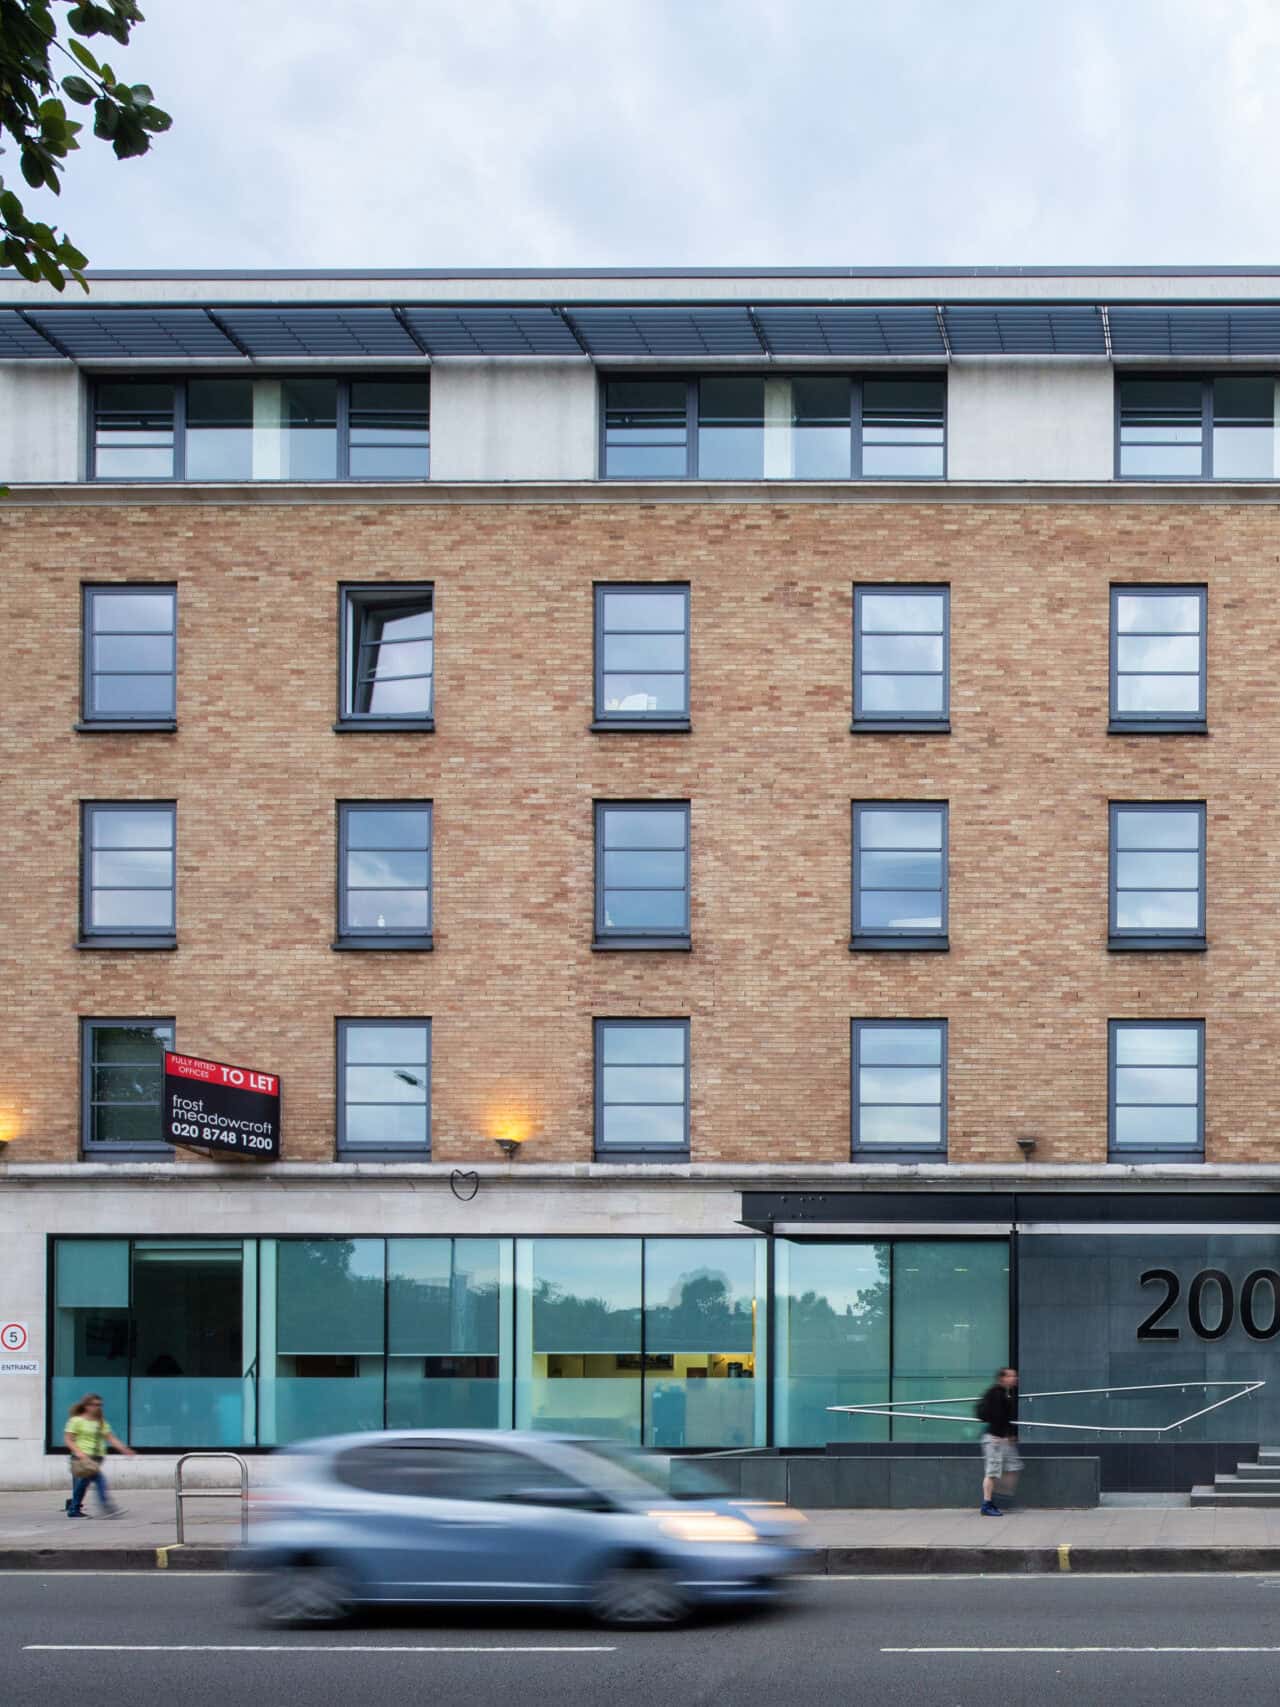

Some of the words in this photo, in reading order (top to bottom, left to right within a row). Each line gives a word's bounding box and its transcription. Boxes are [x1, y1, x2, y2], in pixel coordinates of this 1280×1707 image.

[171, 1055, 192, 1066] FULLY
[194, 1060, 216, 1072] FITTED
[178, 1066, 209, 1079] OFFICES
[221, 1067, 244, 1085] TO
[249, 1073, 274, 1092] LET
[172, 1094, 203, 1112] frost
[172, 1108, 272, 1135] meadowcroft
[171, 1122, 199, 1138] 020
[202, 1127, 237, 1145] 8748
[241, 1134, 273, 1150] 1200
[10, 1331, 18, 1343] 5
